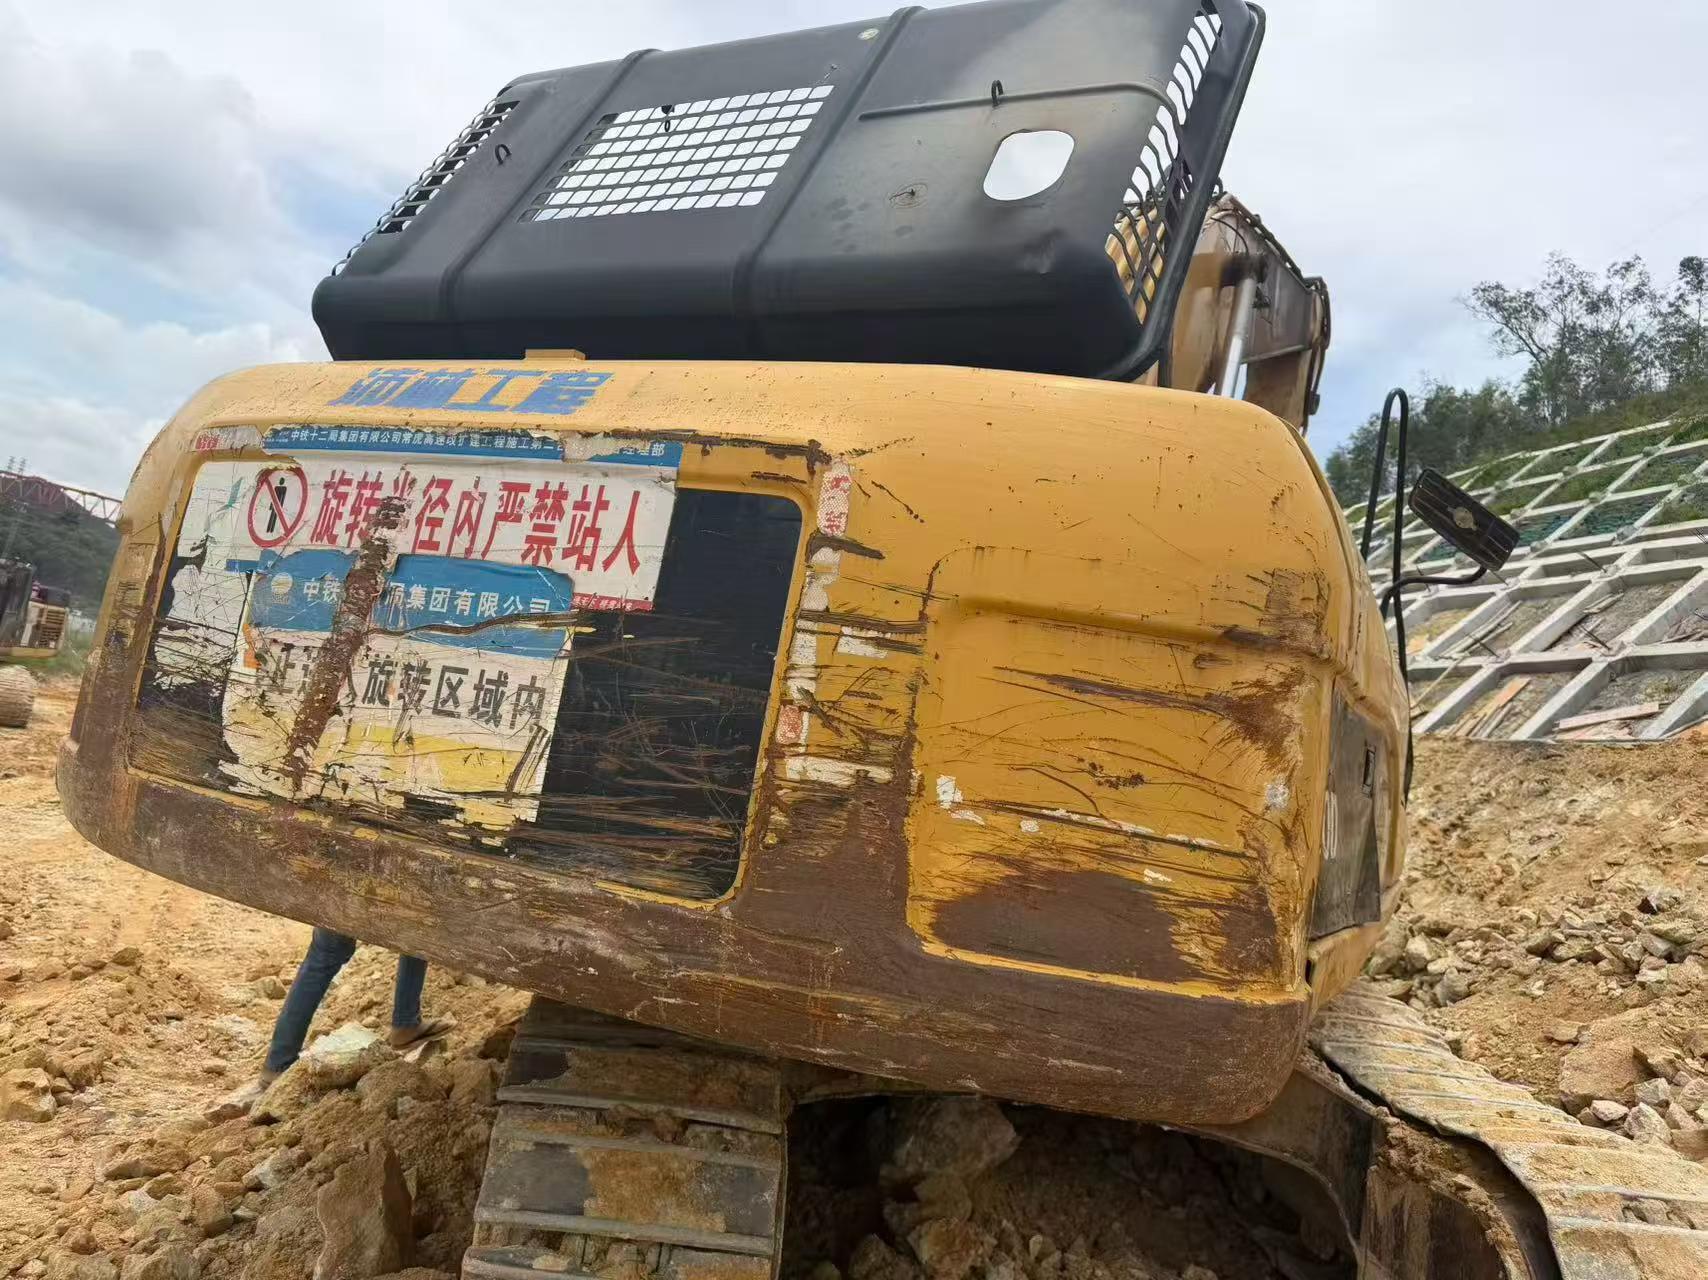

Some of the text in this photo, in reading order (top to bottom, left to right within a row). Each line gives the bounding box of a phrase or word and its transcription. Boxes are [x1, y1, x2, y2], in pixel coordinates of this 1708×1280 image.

[310, 470, 642, 576] 旋转半径内严禁站人
[303, 579, 551, 617] 中铁局集团有限公司
